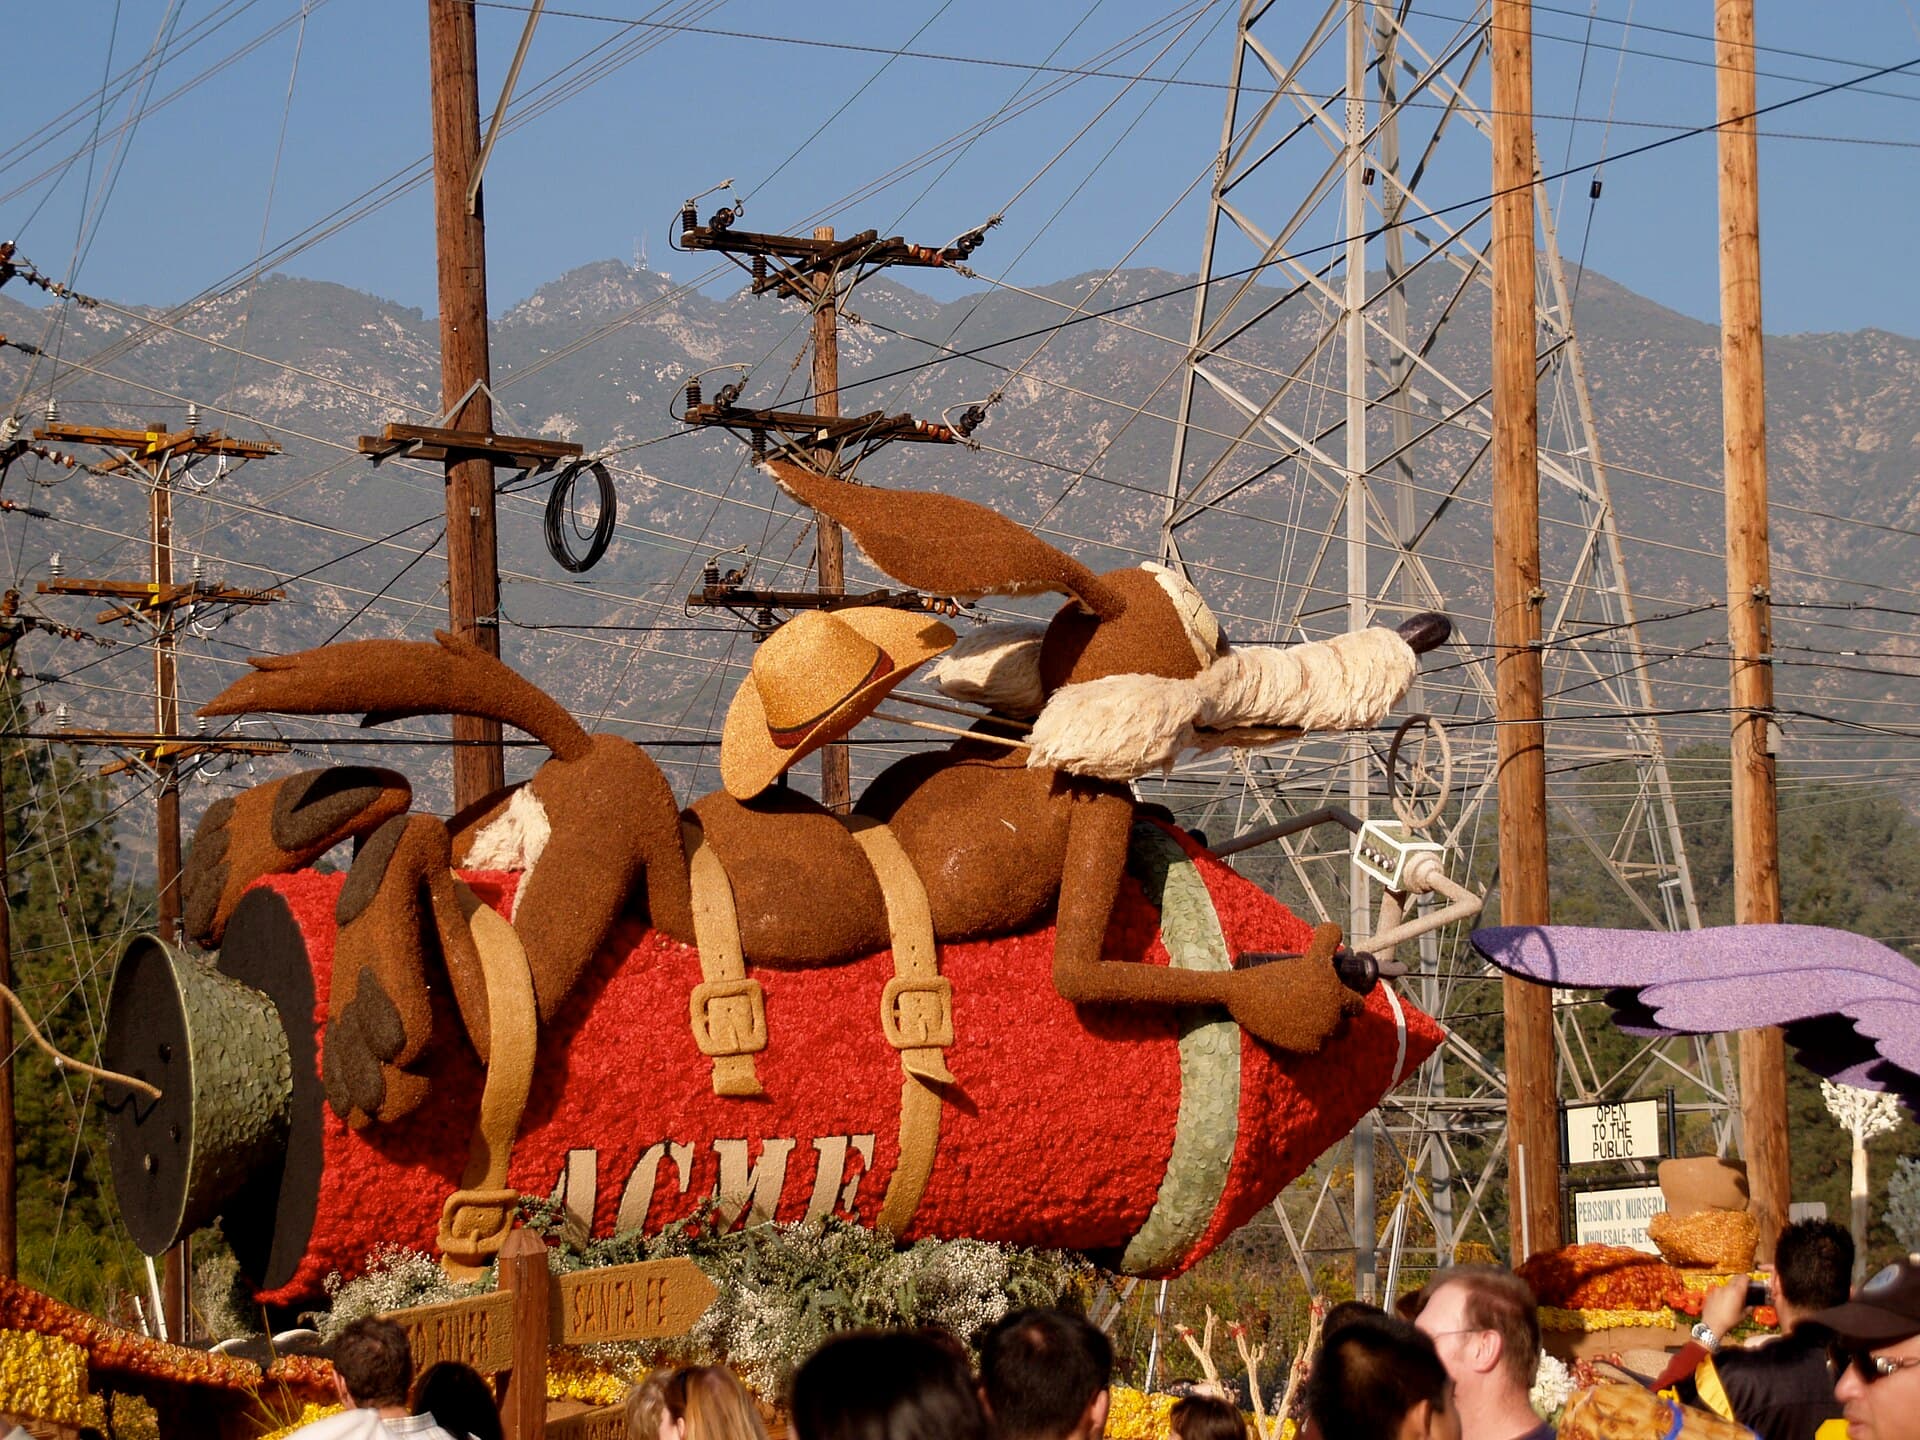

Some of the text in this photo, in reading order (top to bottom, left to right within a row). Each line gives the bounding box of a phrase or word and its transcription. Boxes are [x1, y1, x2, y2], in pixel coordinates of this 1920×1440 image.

[1597, 1103, 1627, 1122] OPEN
[1592, 1120, 1632, 1141] TO THE
[1593, 1139, 1633, 1159] PUBLIC
[549, 1133, 875, 1250] ACME
[1578, 1196, 1663, 1223] PERSSON'S NURSERY
[573, 1276, 670, 1333] SANTA FE
[437, 1310, 489, 1363] RIVER
